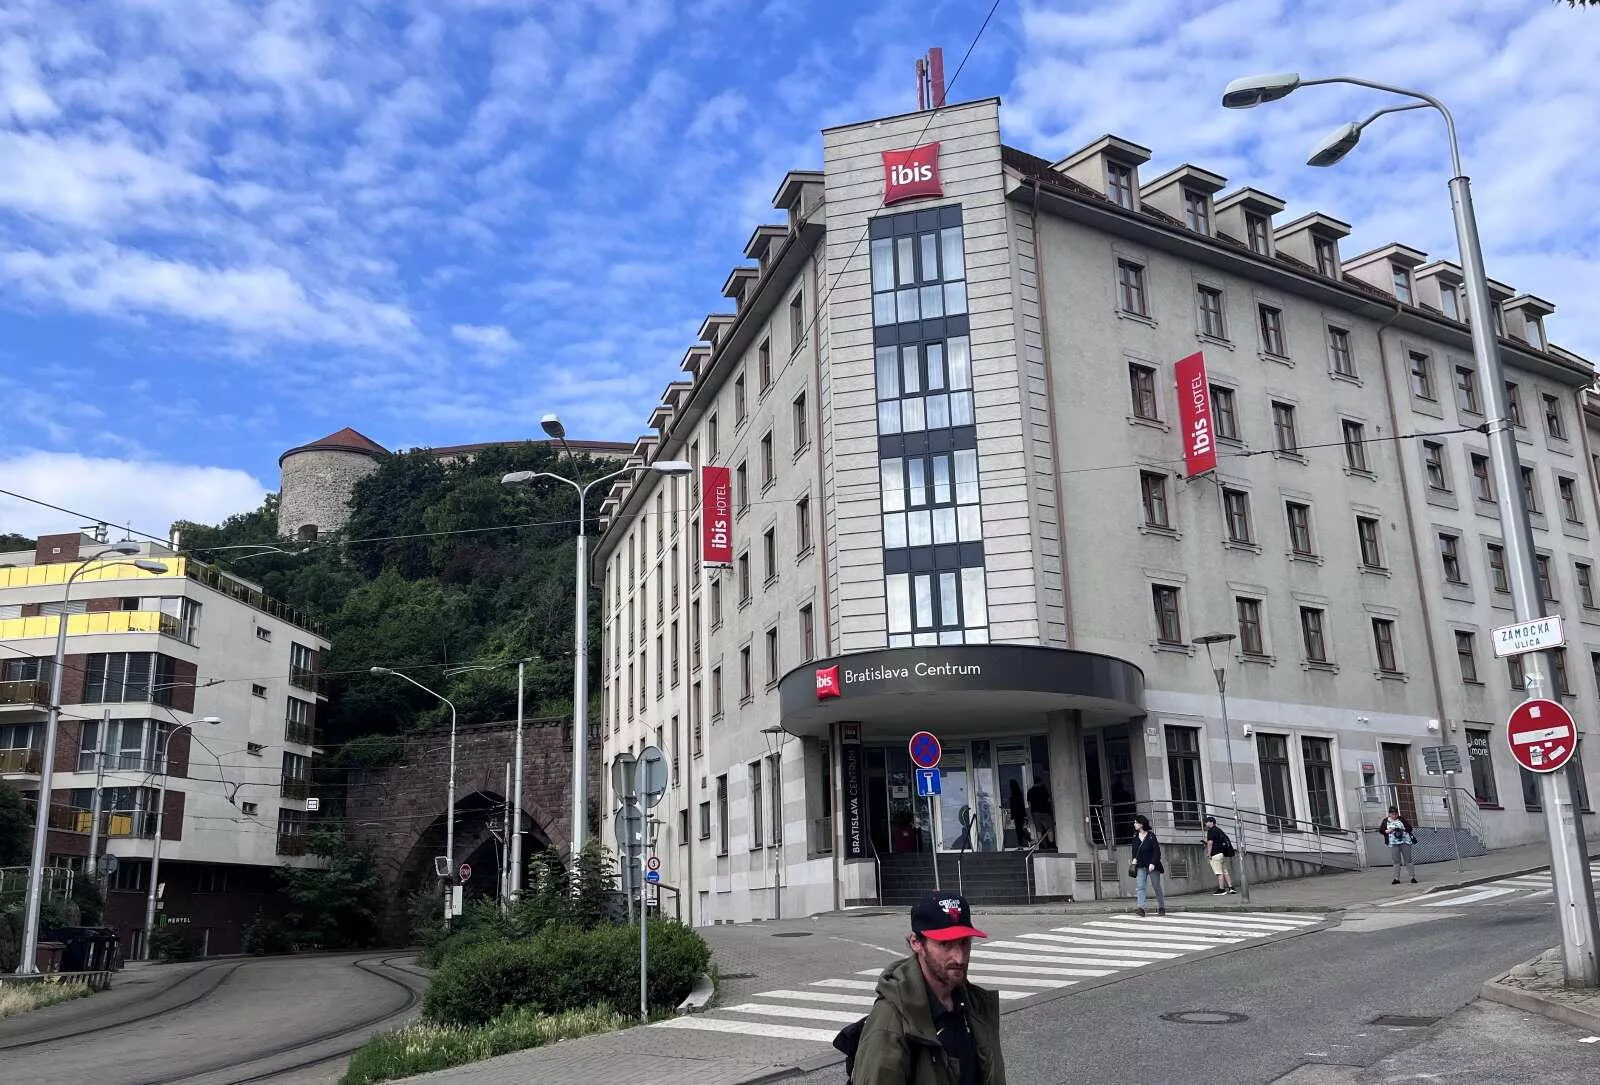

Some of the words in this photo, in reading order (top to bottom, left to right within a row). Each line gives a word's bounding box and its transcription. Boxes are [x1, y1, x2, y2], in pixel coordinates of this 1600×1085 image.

[891, 161, 933, 186] ibis
[1191, 371, 1206, 414] HOTEL
[1191, 418, 1210, 457] ibis
[716, 483, 726, 516] HOTEL
[711, 520, 727, 549] ibis
[1514, 637, 1541, 649] ULICA
[816, 675, 832, 688] ibis
[845, 665, 909, 684] Bratislava
[915, 662, 981, 677] Centrum
[848, 749, 858, 796] CENTRUM
[850, 797, 860, 853] BRATISLAVA
